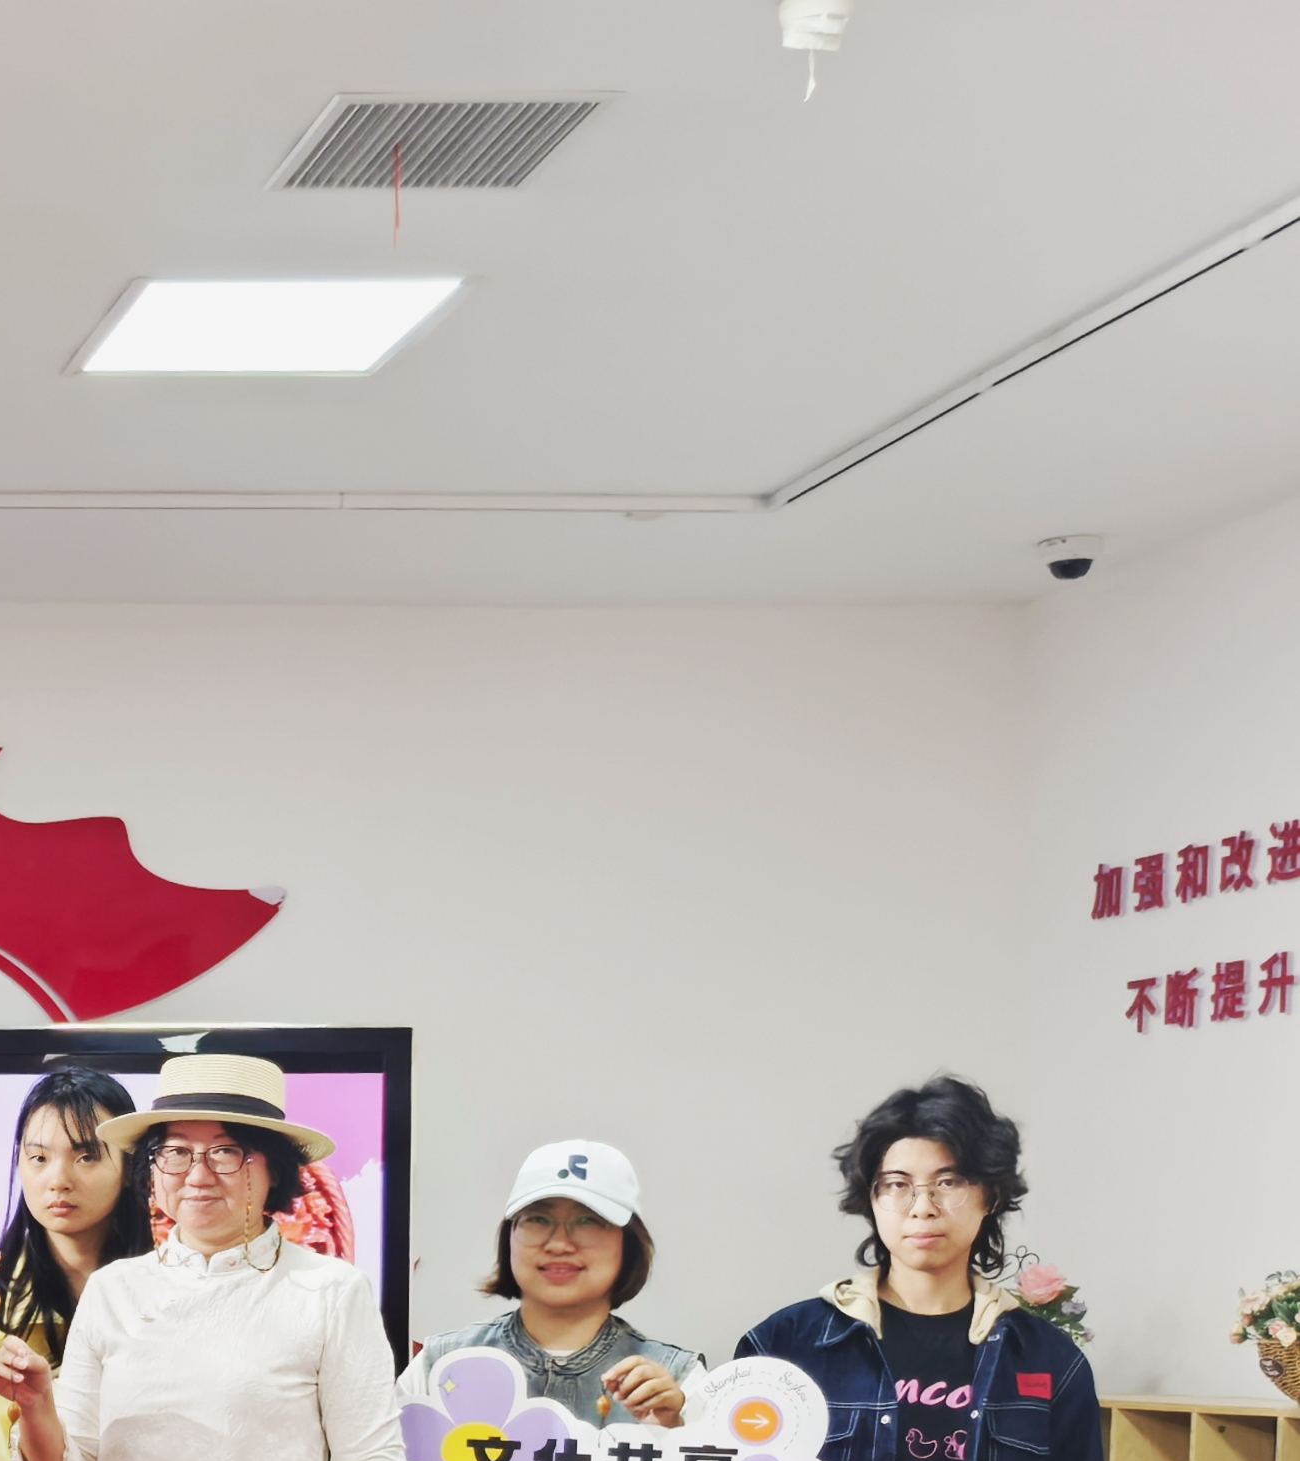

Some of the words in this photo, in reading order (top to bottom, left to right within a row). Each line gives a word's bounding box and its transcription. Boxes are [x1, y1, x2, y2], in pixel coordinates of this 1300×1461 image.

[1091, 819, 1300, 919] 加强和改进
[1125, 951, 1294, 1033] 不断提升
[704, 1367, 752, 1398] Shanghai
